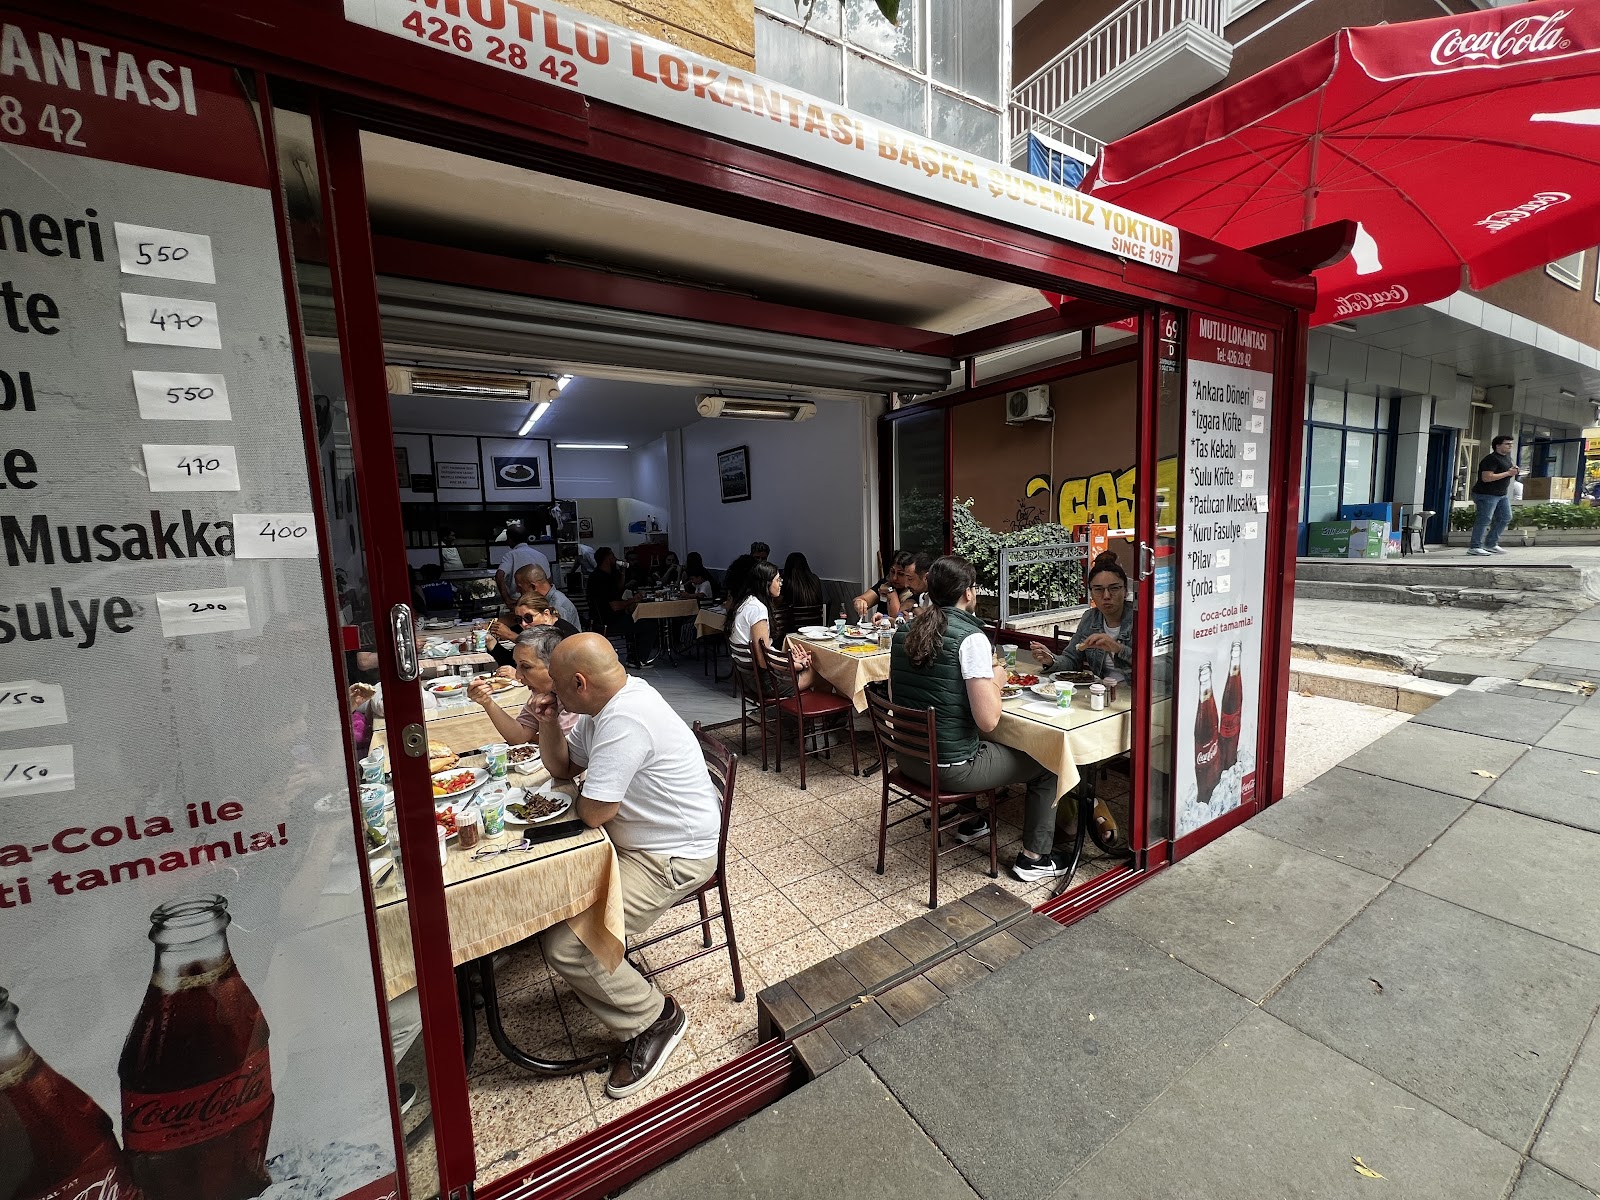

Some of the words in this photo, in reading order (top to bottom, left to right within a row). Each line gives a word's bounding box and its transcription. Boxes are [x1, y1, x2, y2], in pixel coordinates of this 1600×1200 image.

[1430, 8, 1575, 66] Coca-Cola
[402, 10, 473, 53] 426
[486, 35, 528, 70] 28
[539, 55, 579, 88] 42
[1, 23, 198, 116] ANTASI
[38, 104, 87, 148] 42
[630, 42, 865, 151] LOKANTASI
[877, 127, 979, 188] BAŞKA
[1100, 206, 1174, 252] YOKTUR
[136, 242, 190, 265] 550
[1111, 237, 1145, 260] SINCE
[1150, 250, 1174, 267] 1977
[149, 308, 203, 332] 470
[1165, 319, 1179, 339] 69
[1200, 318, 1227, 343] MUTLU
[1228, 325, 1267, 351] LOKANTASI
[1169, 344, 1175, 356] D
[1227, 349, 1237, 365] 426
[1244, 353, 1252, 367] 42
[166, 387, 214, 404] 550
[1226, 384, 1250, 406] Döneri
[1222, 412, 1242, 432] Köfte
[1210, 439, 1237, 459] Kebabı
[177, 457, 221, 476] 470
[1214, 467, 1234, 486] Köfte
[1, 509, 235, 567] Musakka
[259, 522, 308, 543] 400
[1213, 520, 1241, 543] Fasulye
[188, 602, 228, 614] 200
[1200, 605, 1238, 623] Coca-Cola
[1239, 603, 1249, 614] ile
[1192, 623, 1219, 640] lezzeti
[1219, 615, 1254, 633] tamamla!
[186, 800, 244, 829] ile
[47, 822, 290, 896] tamamla!
